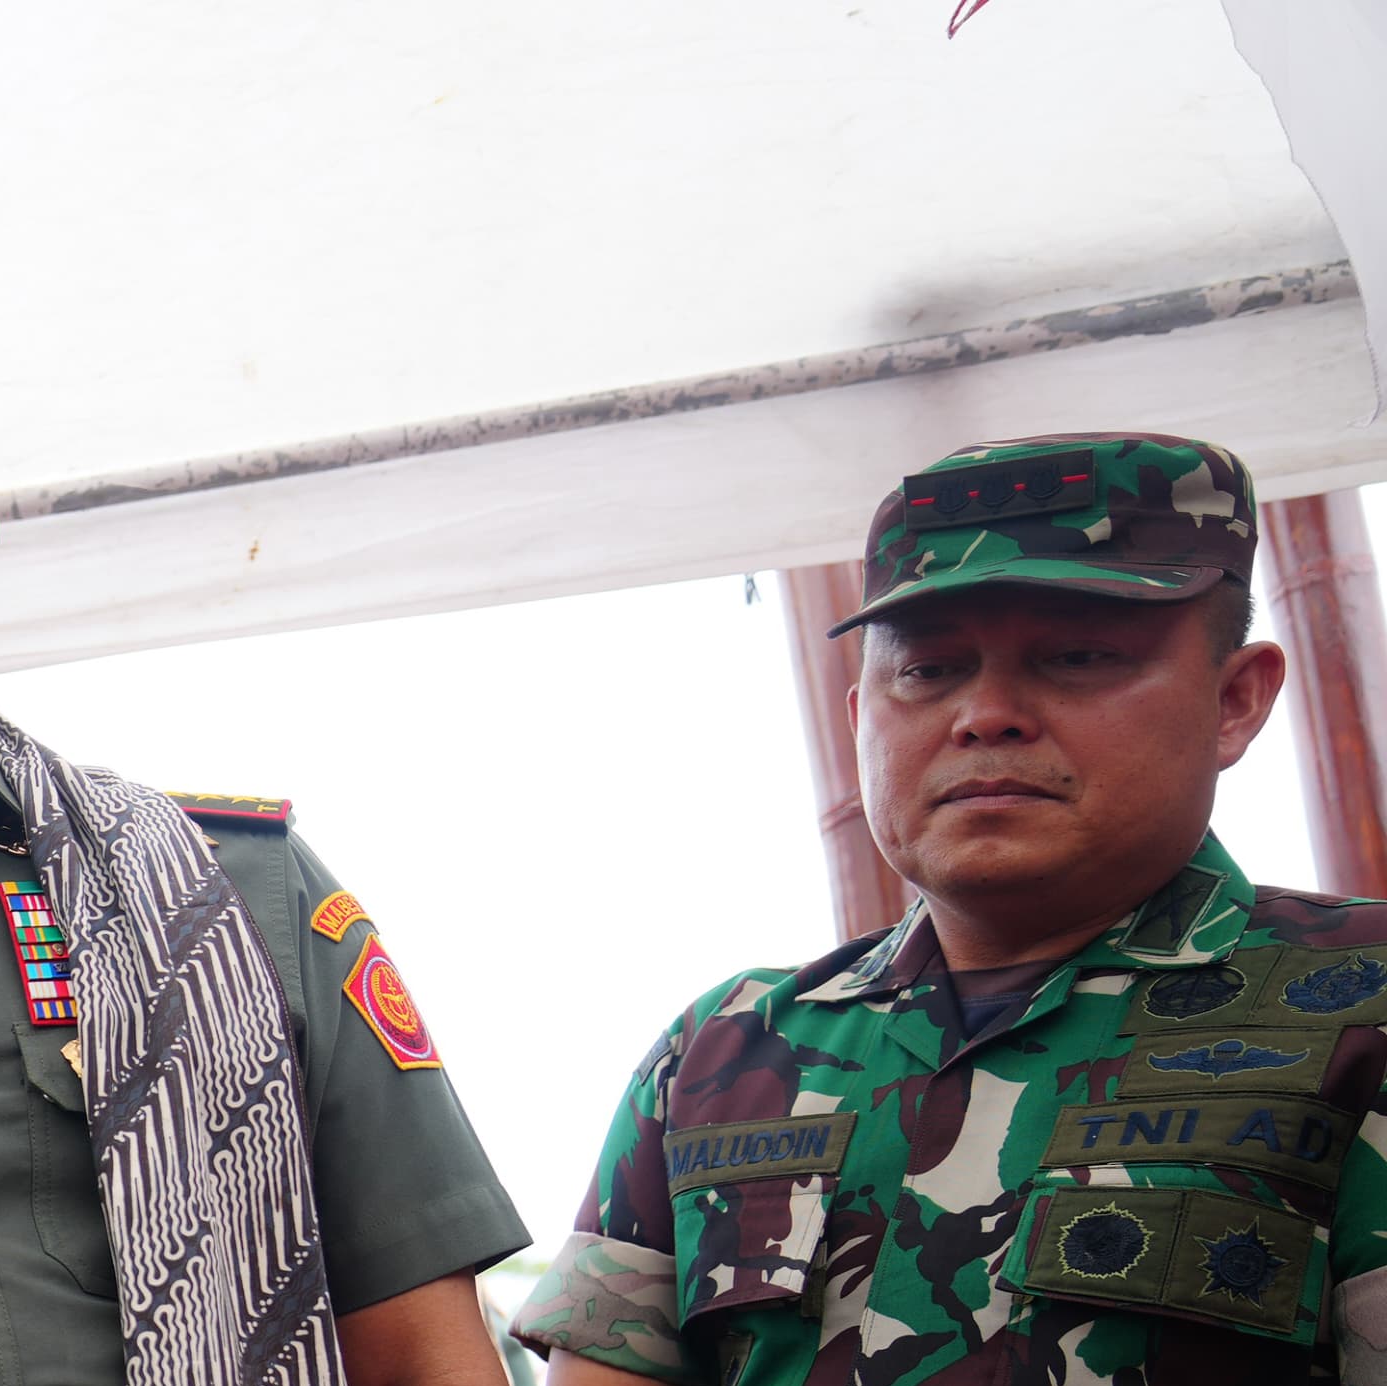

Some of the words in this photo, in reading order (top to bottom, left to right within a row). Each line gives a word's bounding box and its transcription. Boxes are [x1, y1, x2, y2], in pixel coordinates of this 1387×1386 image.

[665, 1124, 833, 1180] MALUDDIN
[1077, 1107, 1201, 1149] TNI
[1226, 1107, 1332, 1164] AD
